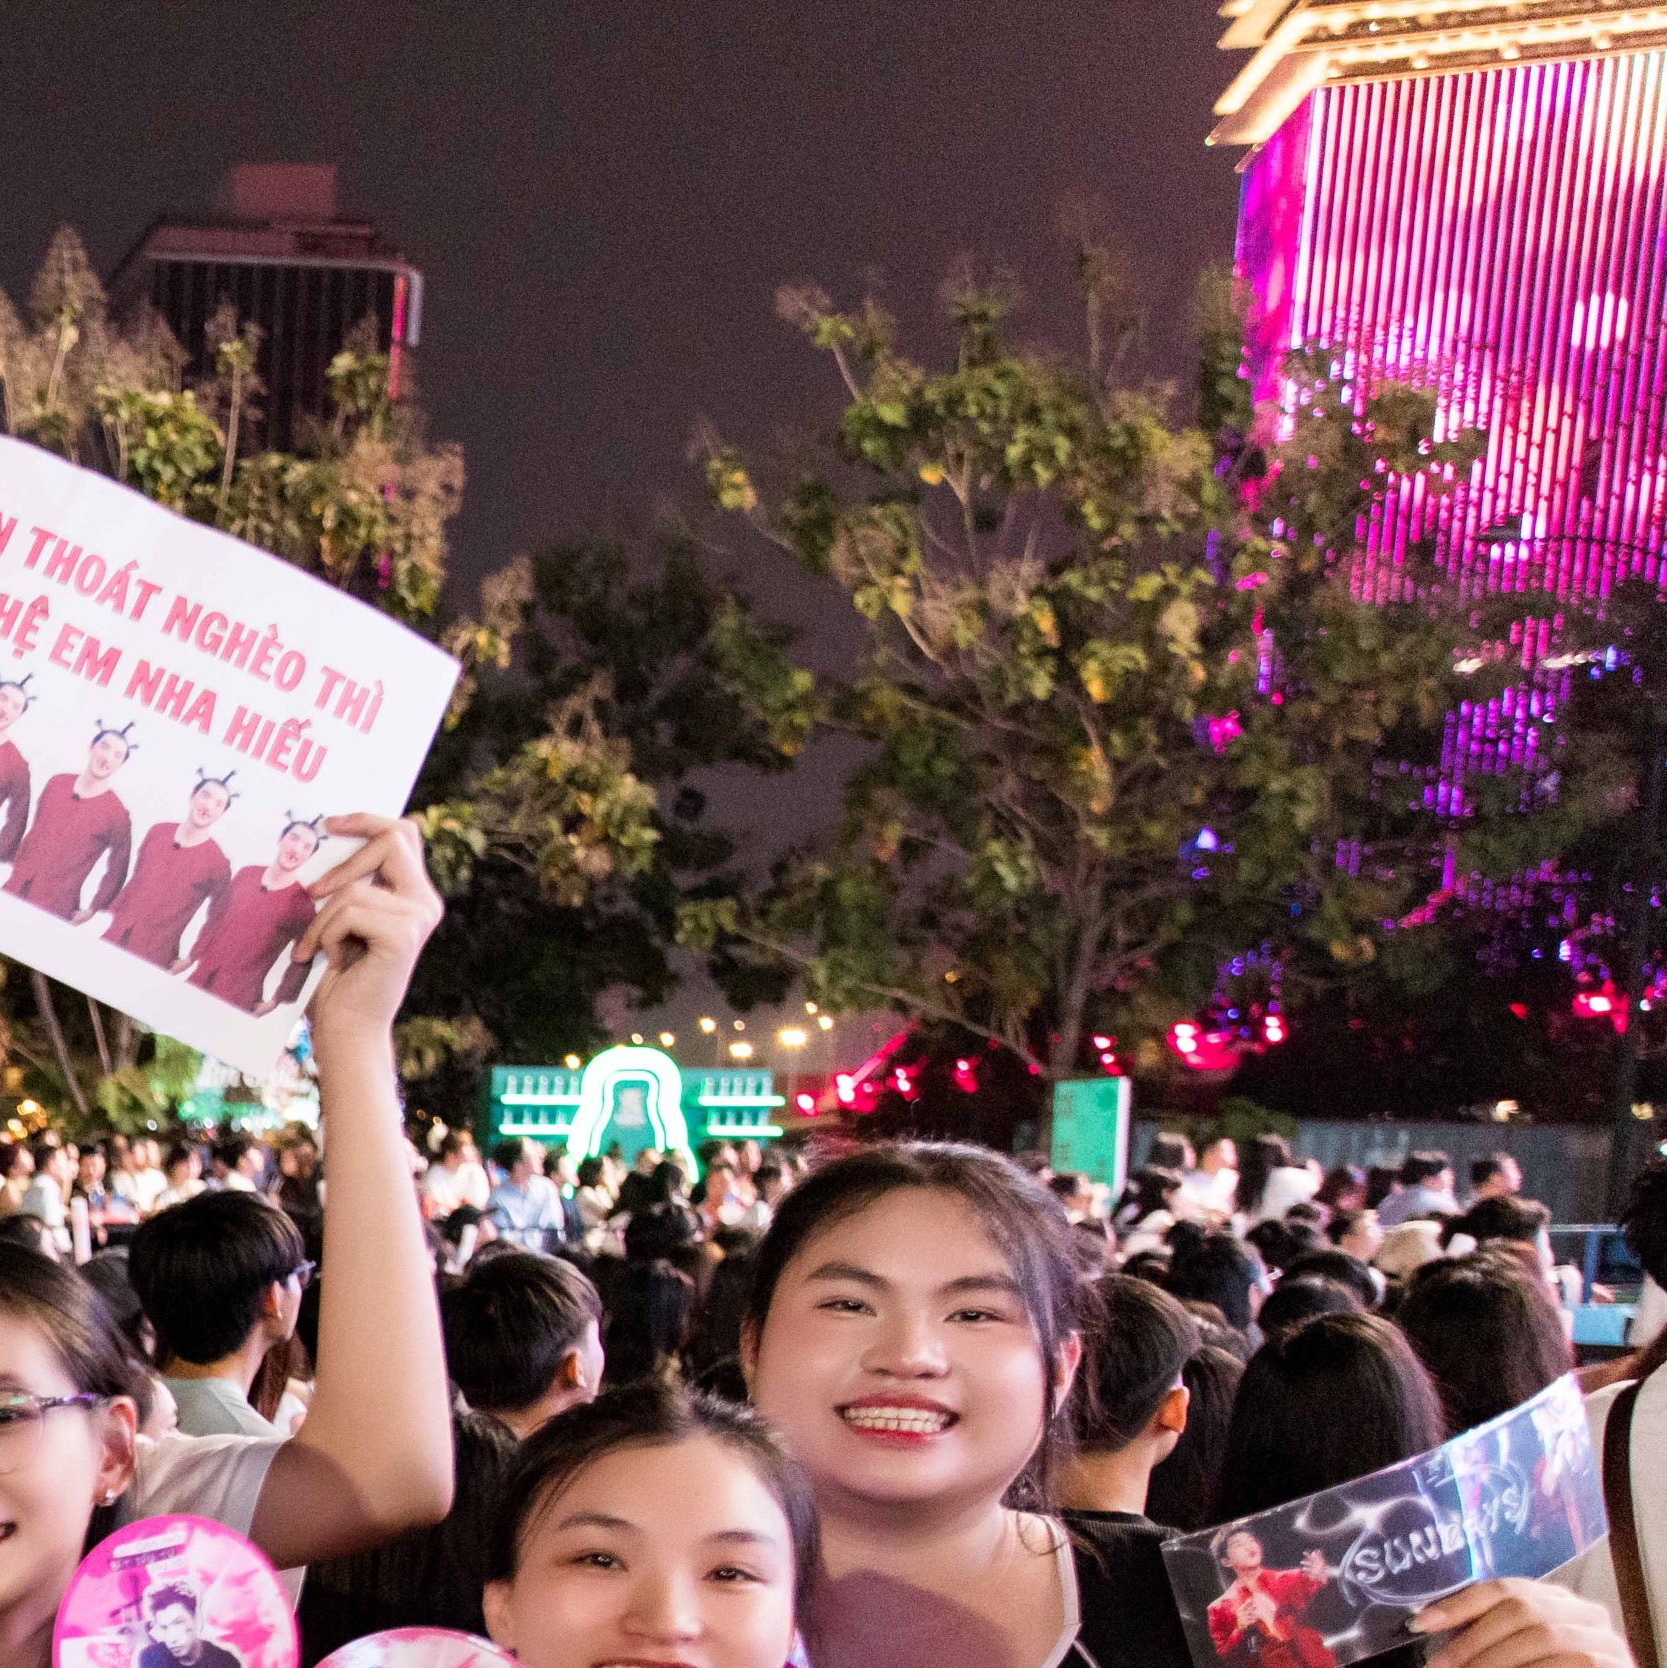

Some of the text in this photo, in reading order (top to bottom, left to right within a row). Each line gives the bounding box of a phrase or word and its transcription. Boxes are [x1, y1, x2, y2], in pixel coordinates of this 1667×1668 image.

[23, 524, 163, 623] THOÁT
[160, 594, 307, 694] NGHÈO
[313, 664, 385, 735] THÌ
[47, 621, 124, 689] EM
[122, 657, 218, 736] NHA
[221, 704, 329, 785] HIẾU
